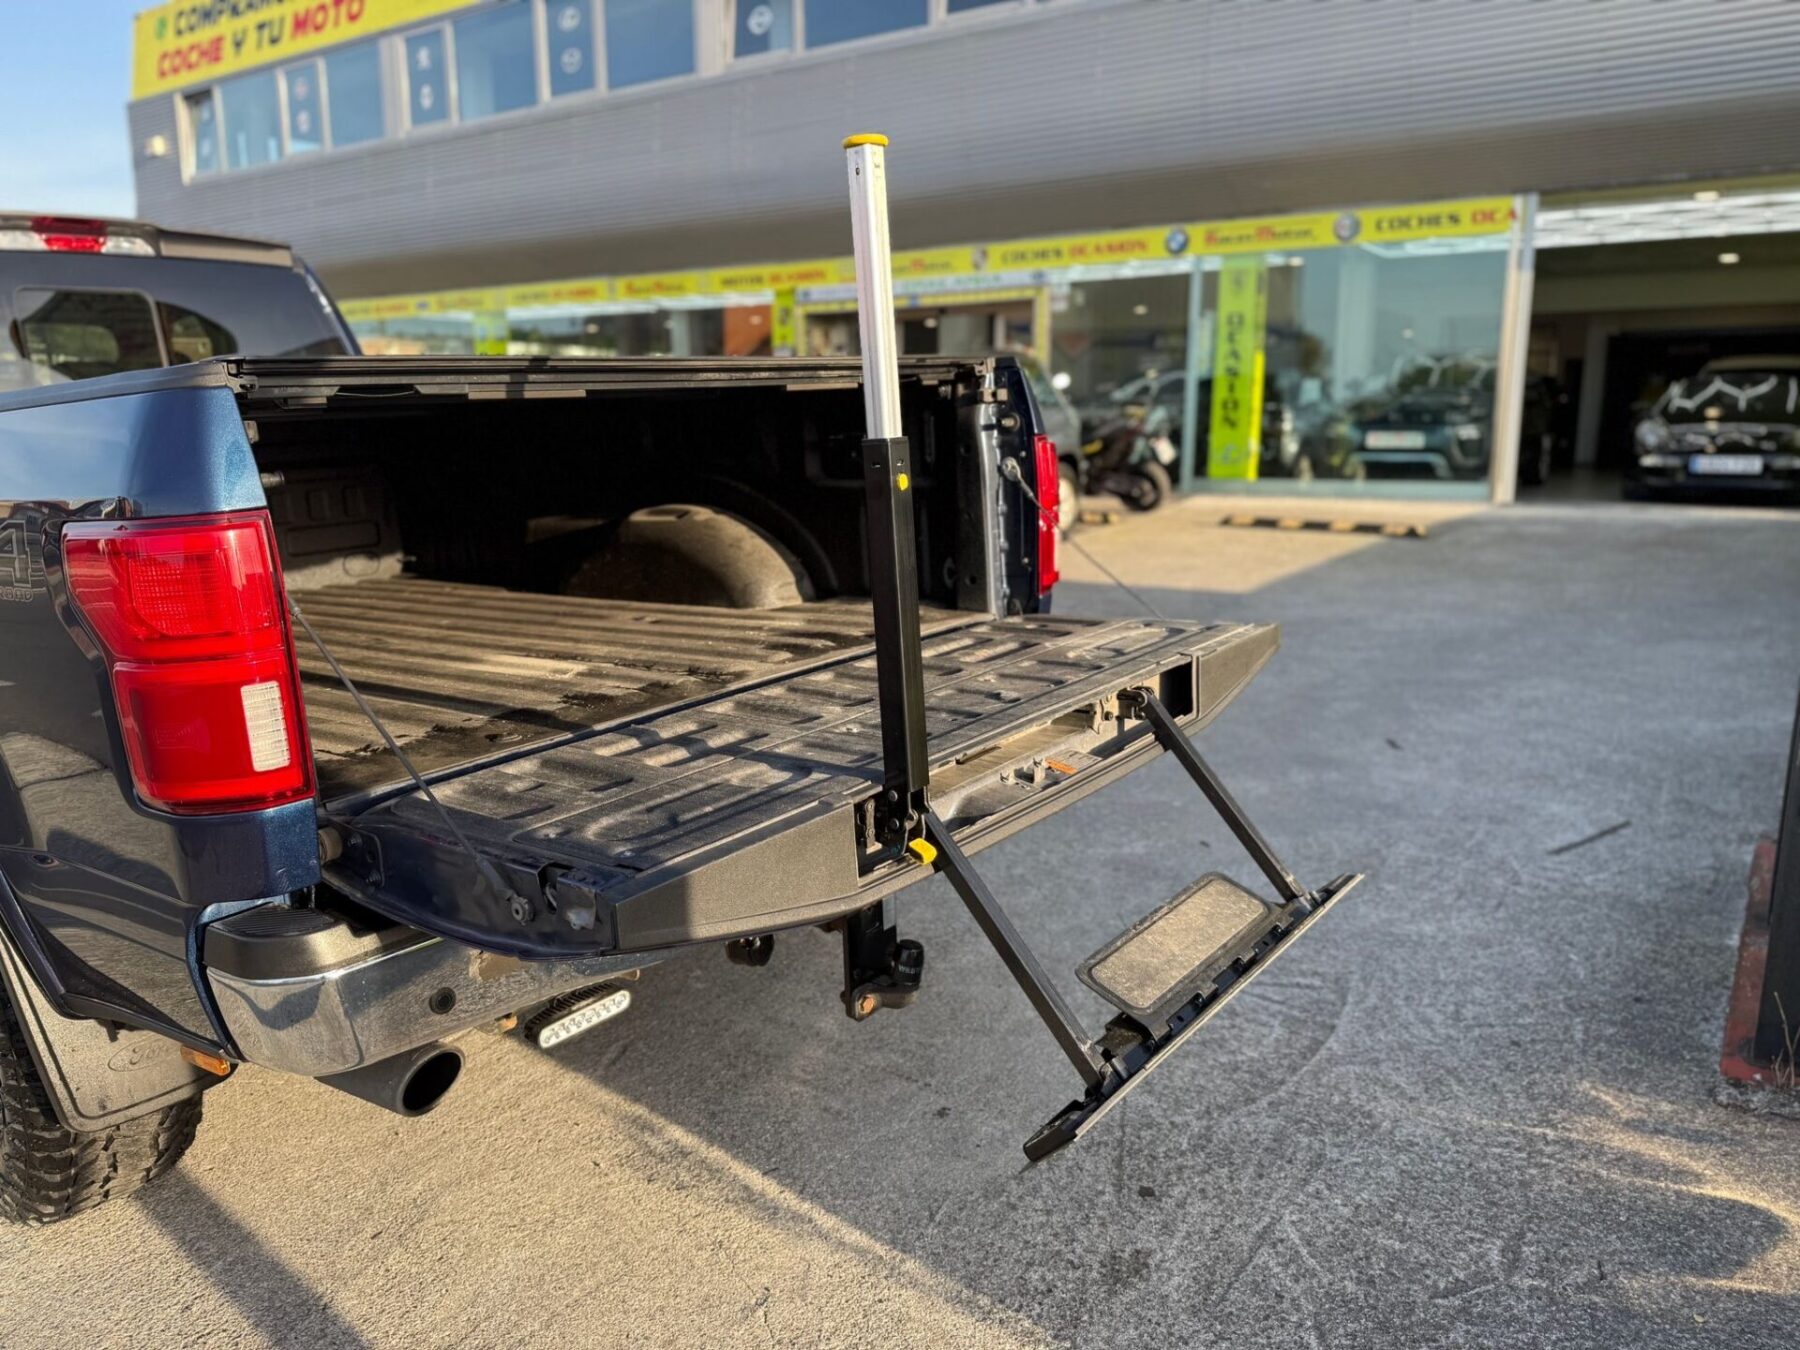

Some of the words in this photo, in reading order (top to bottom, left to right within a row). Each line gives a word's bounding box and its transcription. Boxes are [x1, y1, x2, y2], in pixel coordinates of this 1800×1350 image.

[156, 34, 225, 79] COCHE
[230, 25, 248, 57] Y
[255, 15, 285, 51] TU
[290, 0, 366, 41] MOTO
[1375, 213, 1461, 232] COCHES
